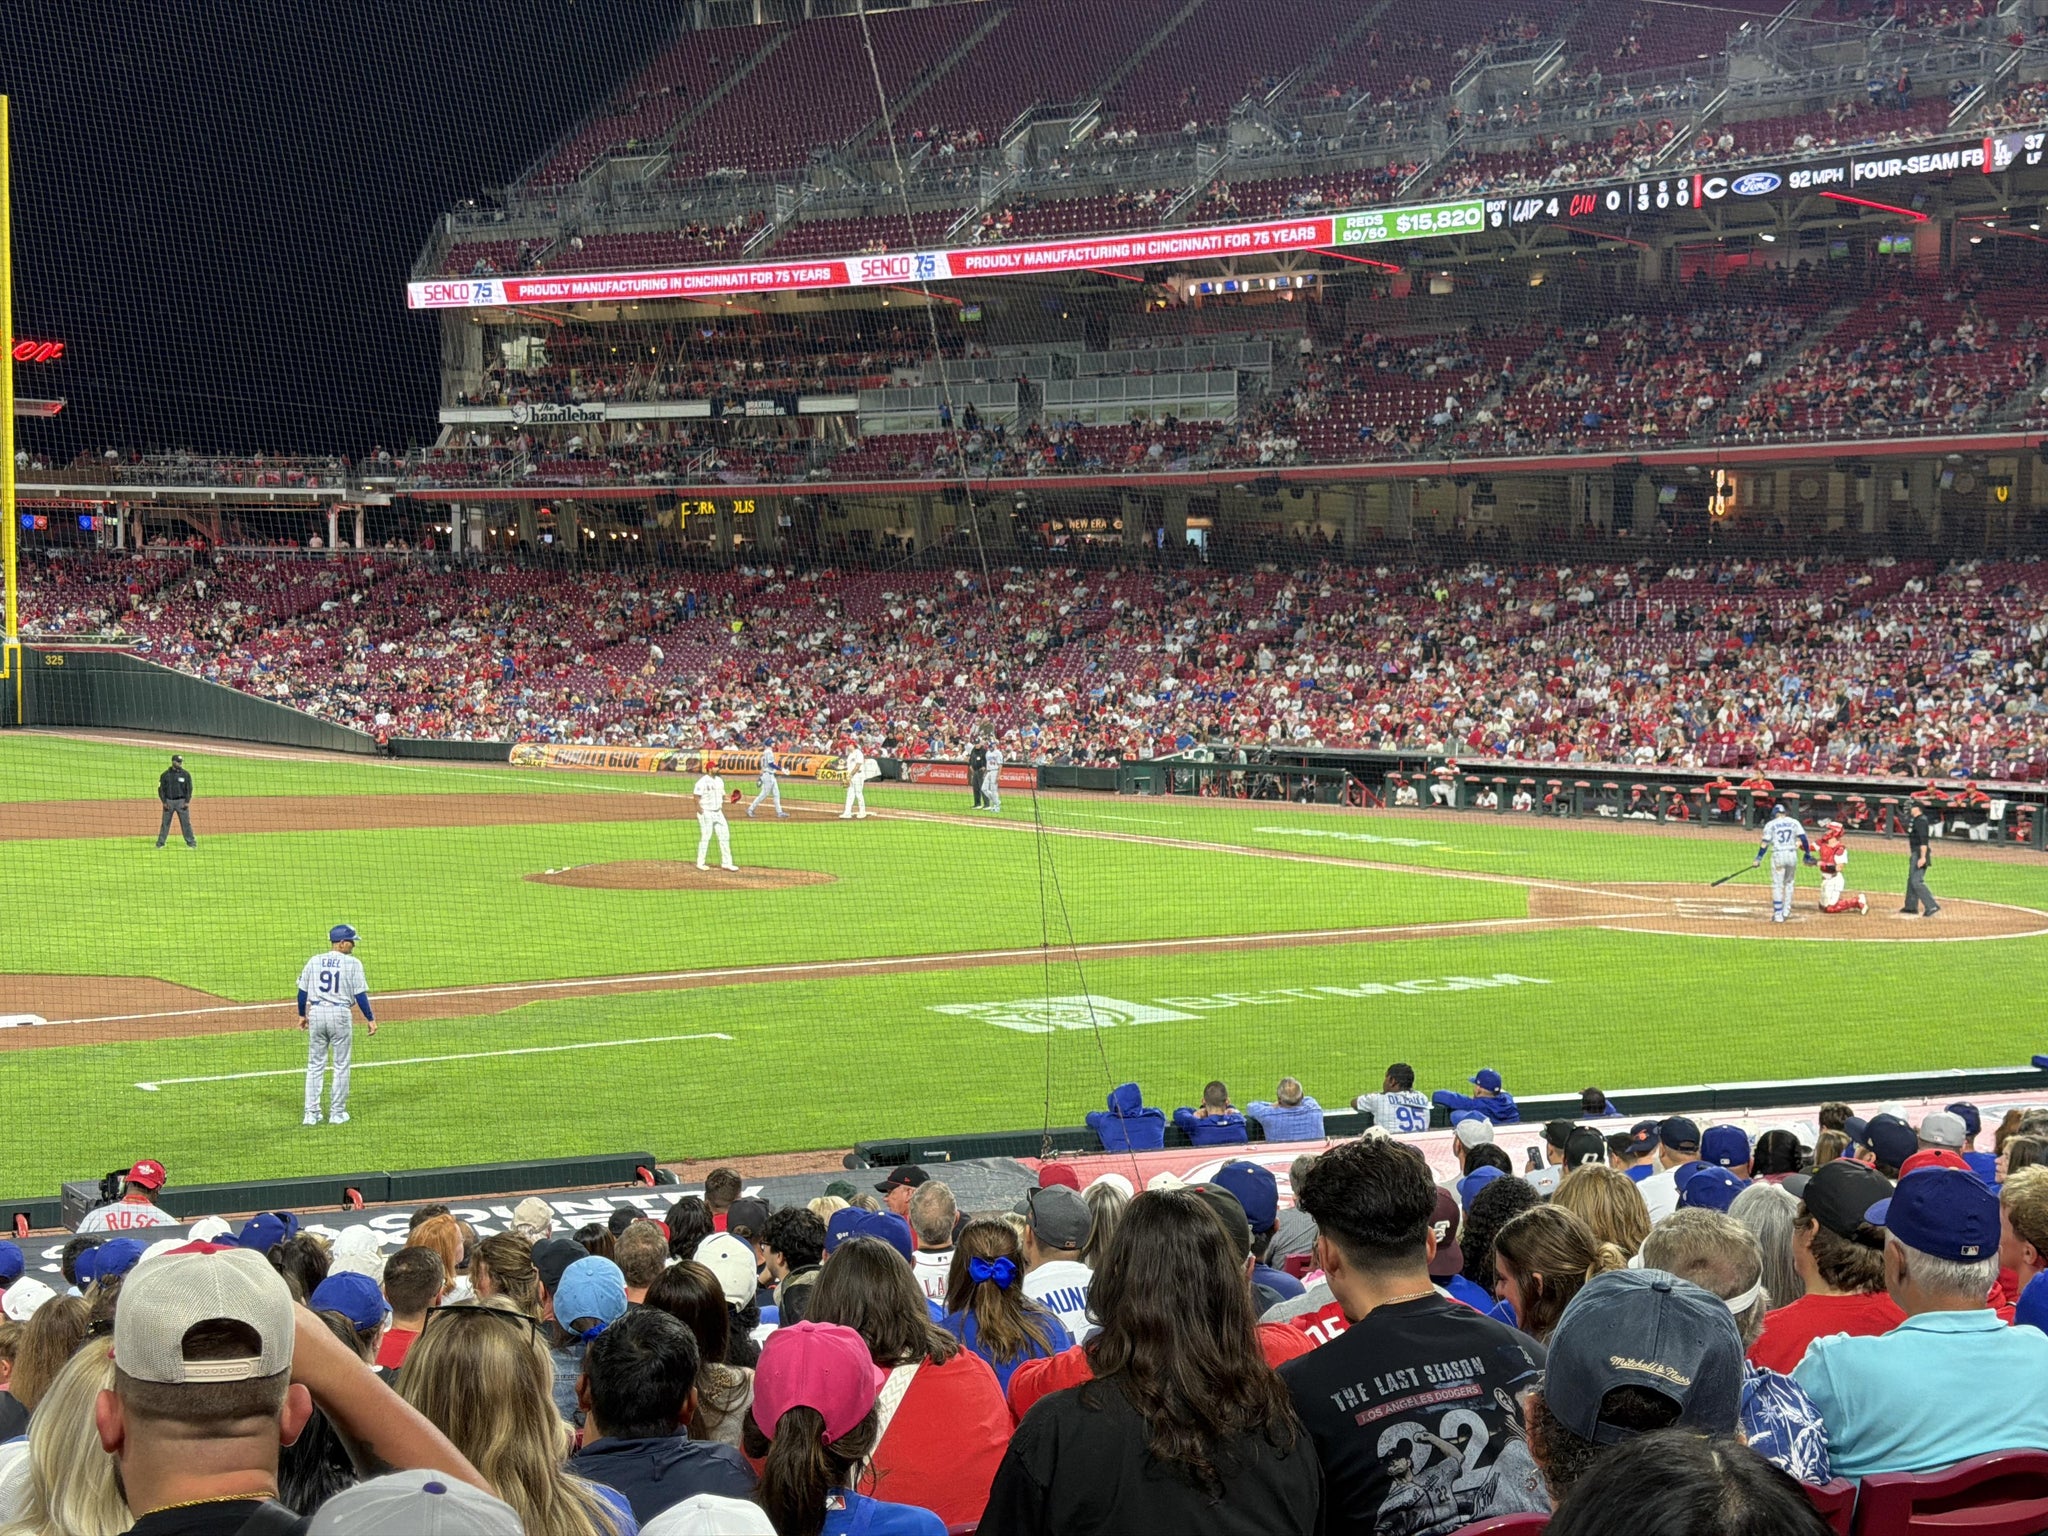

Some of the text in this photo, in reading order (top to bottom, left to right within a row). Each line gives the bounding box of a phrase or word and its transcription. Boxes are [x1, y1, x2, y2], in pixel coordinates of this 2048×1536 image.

[2024, 133, 2046, 150] 37
[2026, 151, 2043, 165] LF
[1789, 148, 1985, 189] 92 MPH FOUR-SEAM FB
[1486, 201, 1507, 213] BOT
[1569, 190, 1621, 217] CIN 0
[1637, 195, 1650, 211] 3
[1656, 192, 1670, 209] 0
[1676, 190, 1690, 207] 0
[1512, 197, 1560, 223] LAD 4
[1346, 214, 1384, 229] REDS
[1396, 207, 1481, 233] $15,820
[1491, 212, 1503, 227] 9
[965, 226, 1316, 270] PROUDLY MANUFACTURING IN CINCINNATI FOR 75 YEARS
[861, 254, 936, 277] SENCO 75
[424, 283, 493, 300] SENCO 75
[519, 267, 831, 298] PROUDLY MANUFACTURING IN CINCINNATI FOR 75 YEARS
[530, 406, 604, 422] handlebar
[45, 655, 64, 665] 325
[608, 751, 640, 769] GLUE
[1776, 829, 1793, 844] 37
[321, 958, 342, 968] EBEL
[318, 970, 341, 994] 91
[1396, 1106, 1426, 1132] 95
[1610, 1355, 1657, 1373] Mitchell
[1664, 1366, 1691, 1386] Ness
[1330, 1355, 1487, 1413] THE LAST SEASON
[1361, 1385, 1480, 1424] LOS ANGELES DODGERS
[1376, 1408, 1500, 1494] 22
